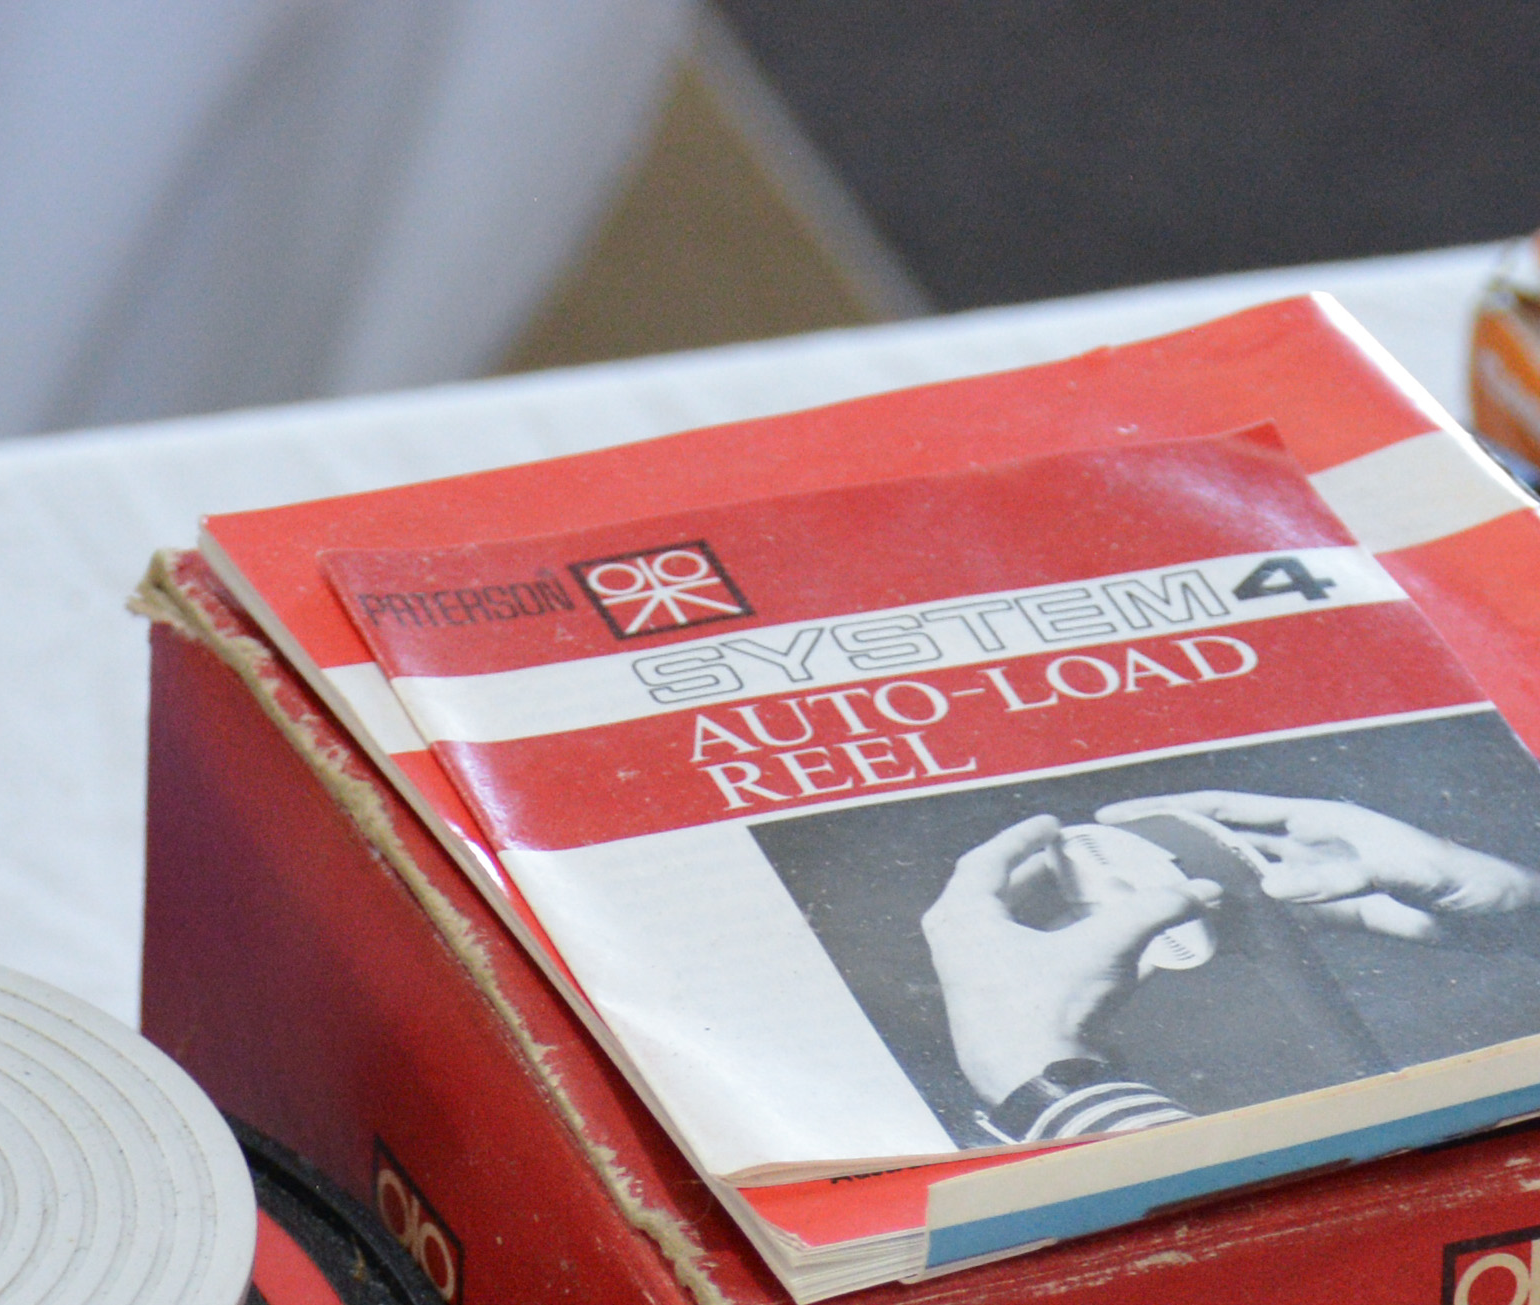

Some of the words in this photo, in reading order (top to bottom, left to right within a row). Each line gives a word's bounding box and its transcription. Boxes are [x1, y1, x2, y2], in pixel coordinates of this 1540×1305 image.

[358, 579, 575, 627] PATERSON
[688, 635, 1257, 764] AUTO-LOAD
[699, 733, 976, 811] REEL
